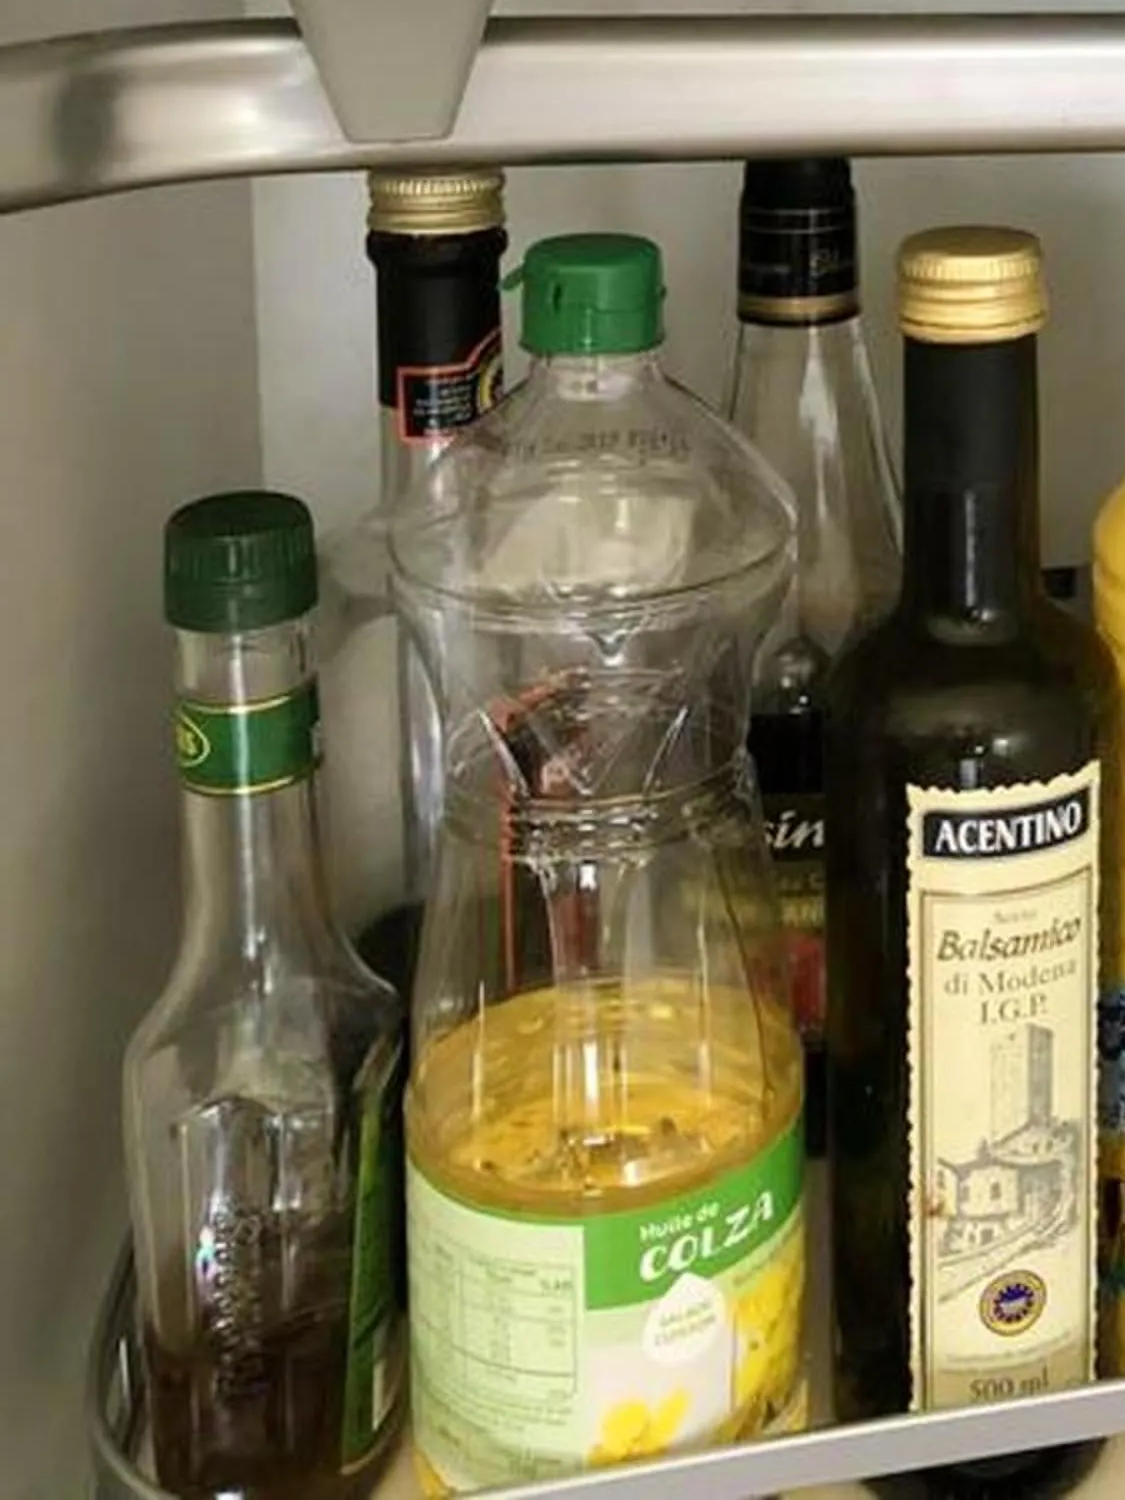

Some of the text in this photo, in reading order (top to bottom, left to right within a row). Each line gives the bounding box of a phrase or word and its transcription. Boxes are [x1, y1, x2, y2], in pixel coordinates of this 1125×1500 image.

[935, 801, 1082, 854] ACENTINO
[937, 915, 1082, 962] Balsamico
[943, 959, 1077, 996] di Modena
[639, 1189, 774, 1284] COLZA
[970, 1376, 1014, 1400] 500
